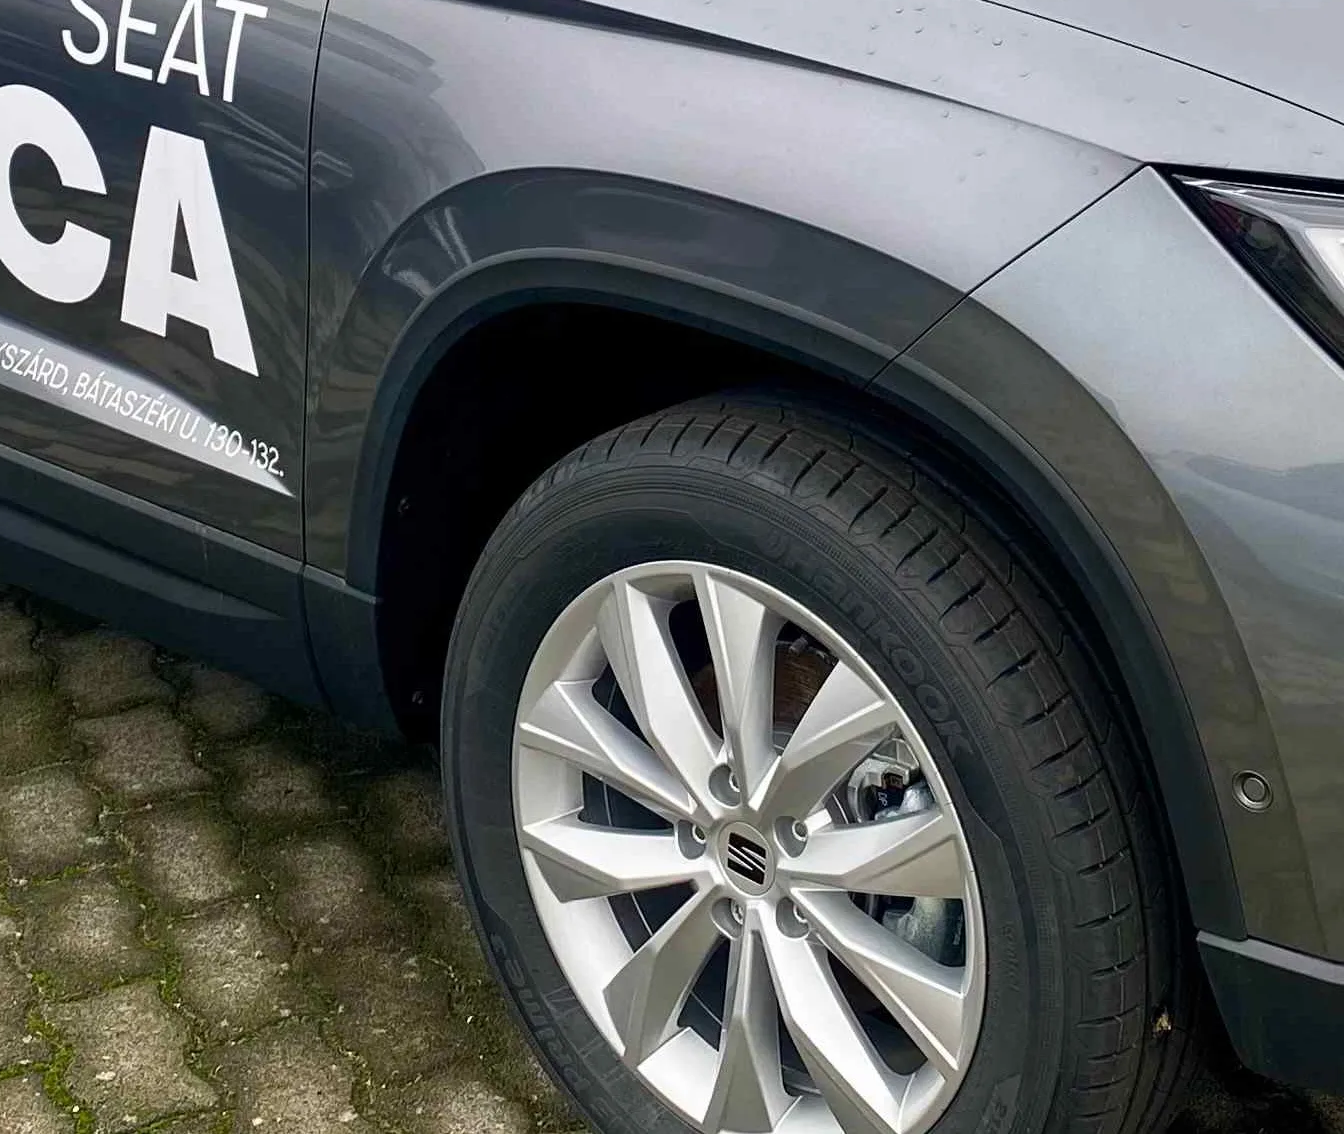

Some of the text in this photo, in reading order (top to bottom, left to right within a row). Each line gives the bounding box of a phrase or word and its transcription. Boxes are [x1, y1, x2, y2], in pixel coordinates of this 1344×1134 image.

[72, 370, 178, 433] BÁTASZÉKI
[179, 412, 199, 443] U.
[205, 421, 285, 478] 130-132.
